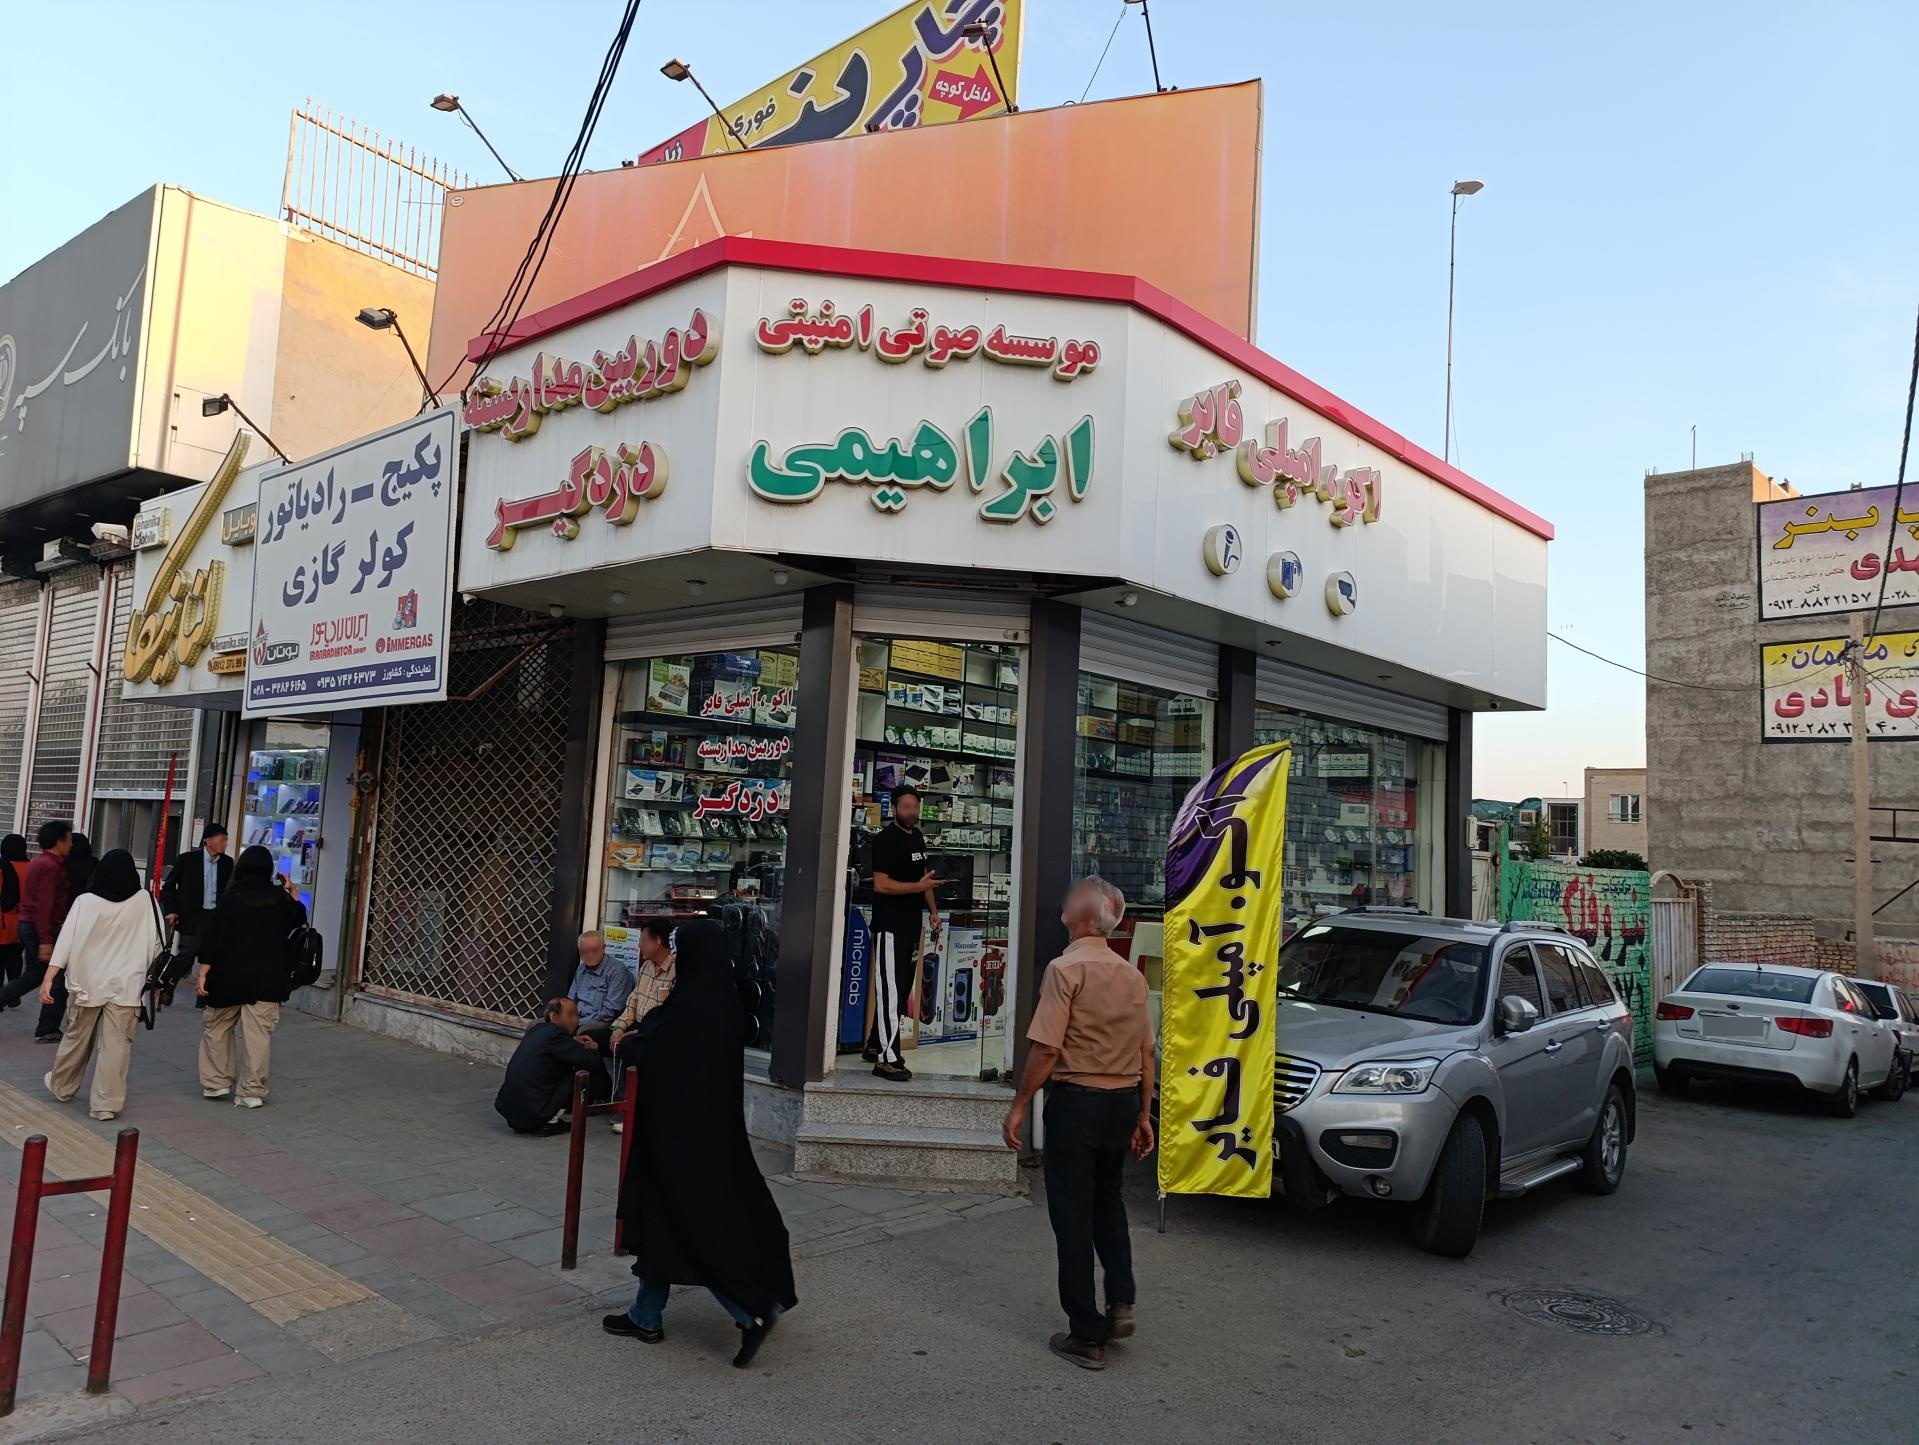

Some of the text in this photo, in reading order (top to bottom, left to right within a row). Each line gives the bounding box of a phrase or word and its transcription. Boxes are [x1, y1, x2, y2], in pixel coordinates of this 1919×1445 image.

[728, 97, 776, 137] فوری
[935, 79, 991, 102] داخل کوچه
[13, 263, 146, 433] بانک سپه
[582, 308, 714, 412] دوربین
[755, 297, 1101, 382] موسسه صوتی امنیتی
[1172, 380, 1243, 461] فایر
[381, 432, 442, 507] پکیج
[747, 405, 1096, 524] ابراهیمی
[223, 509, 257, 541] وبایل
[261, 466, 346, 544] رادیاتور
[486, 441, 664, 551] دزدگیر
[1333, 467, 1381, 527] اکو
[1773, 506, 1879, 550] بنر
[282, 520, 414, 607] کولر گازی
[266, 642, 299, 661] بوتان
[382, 667, 402, 681] کشاورز
[406, 664, 432, 678] نمایندگی
[1770, 653, 1788, 665] در
[700, 691, 723, 716] فایر
[724, 687, 760, 715] آمپلی
[771, 688, 793, 713] اکو
[746, 736, 790, 760] دوربین
[693, 781, 780, 828] دزدگیر
[1195, 795, 1262, 891] اکو
[849, 929, 864, 1006] microlab
[1188, 918, 1264, 1041] آمپلی
[1185, 1055, 1257, 1171] فایر
